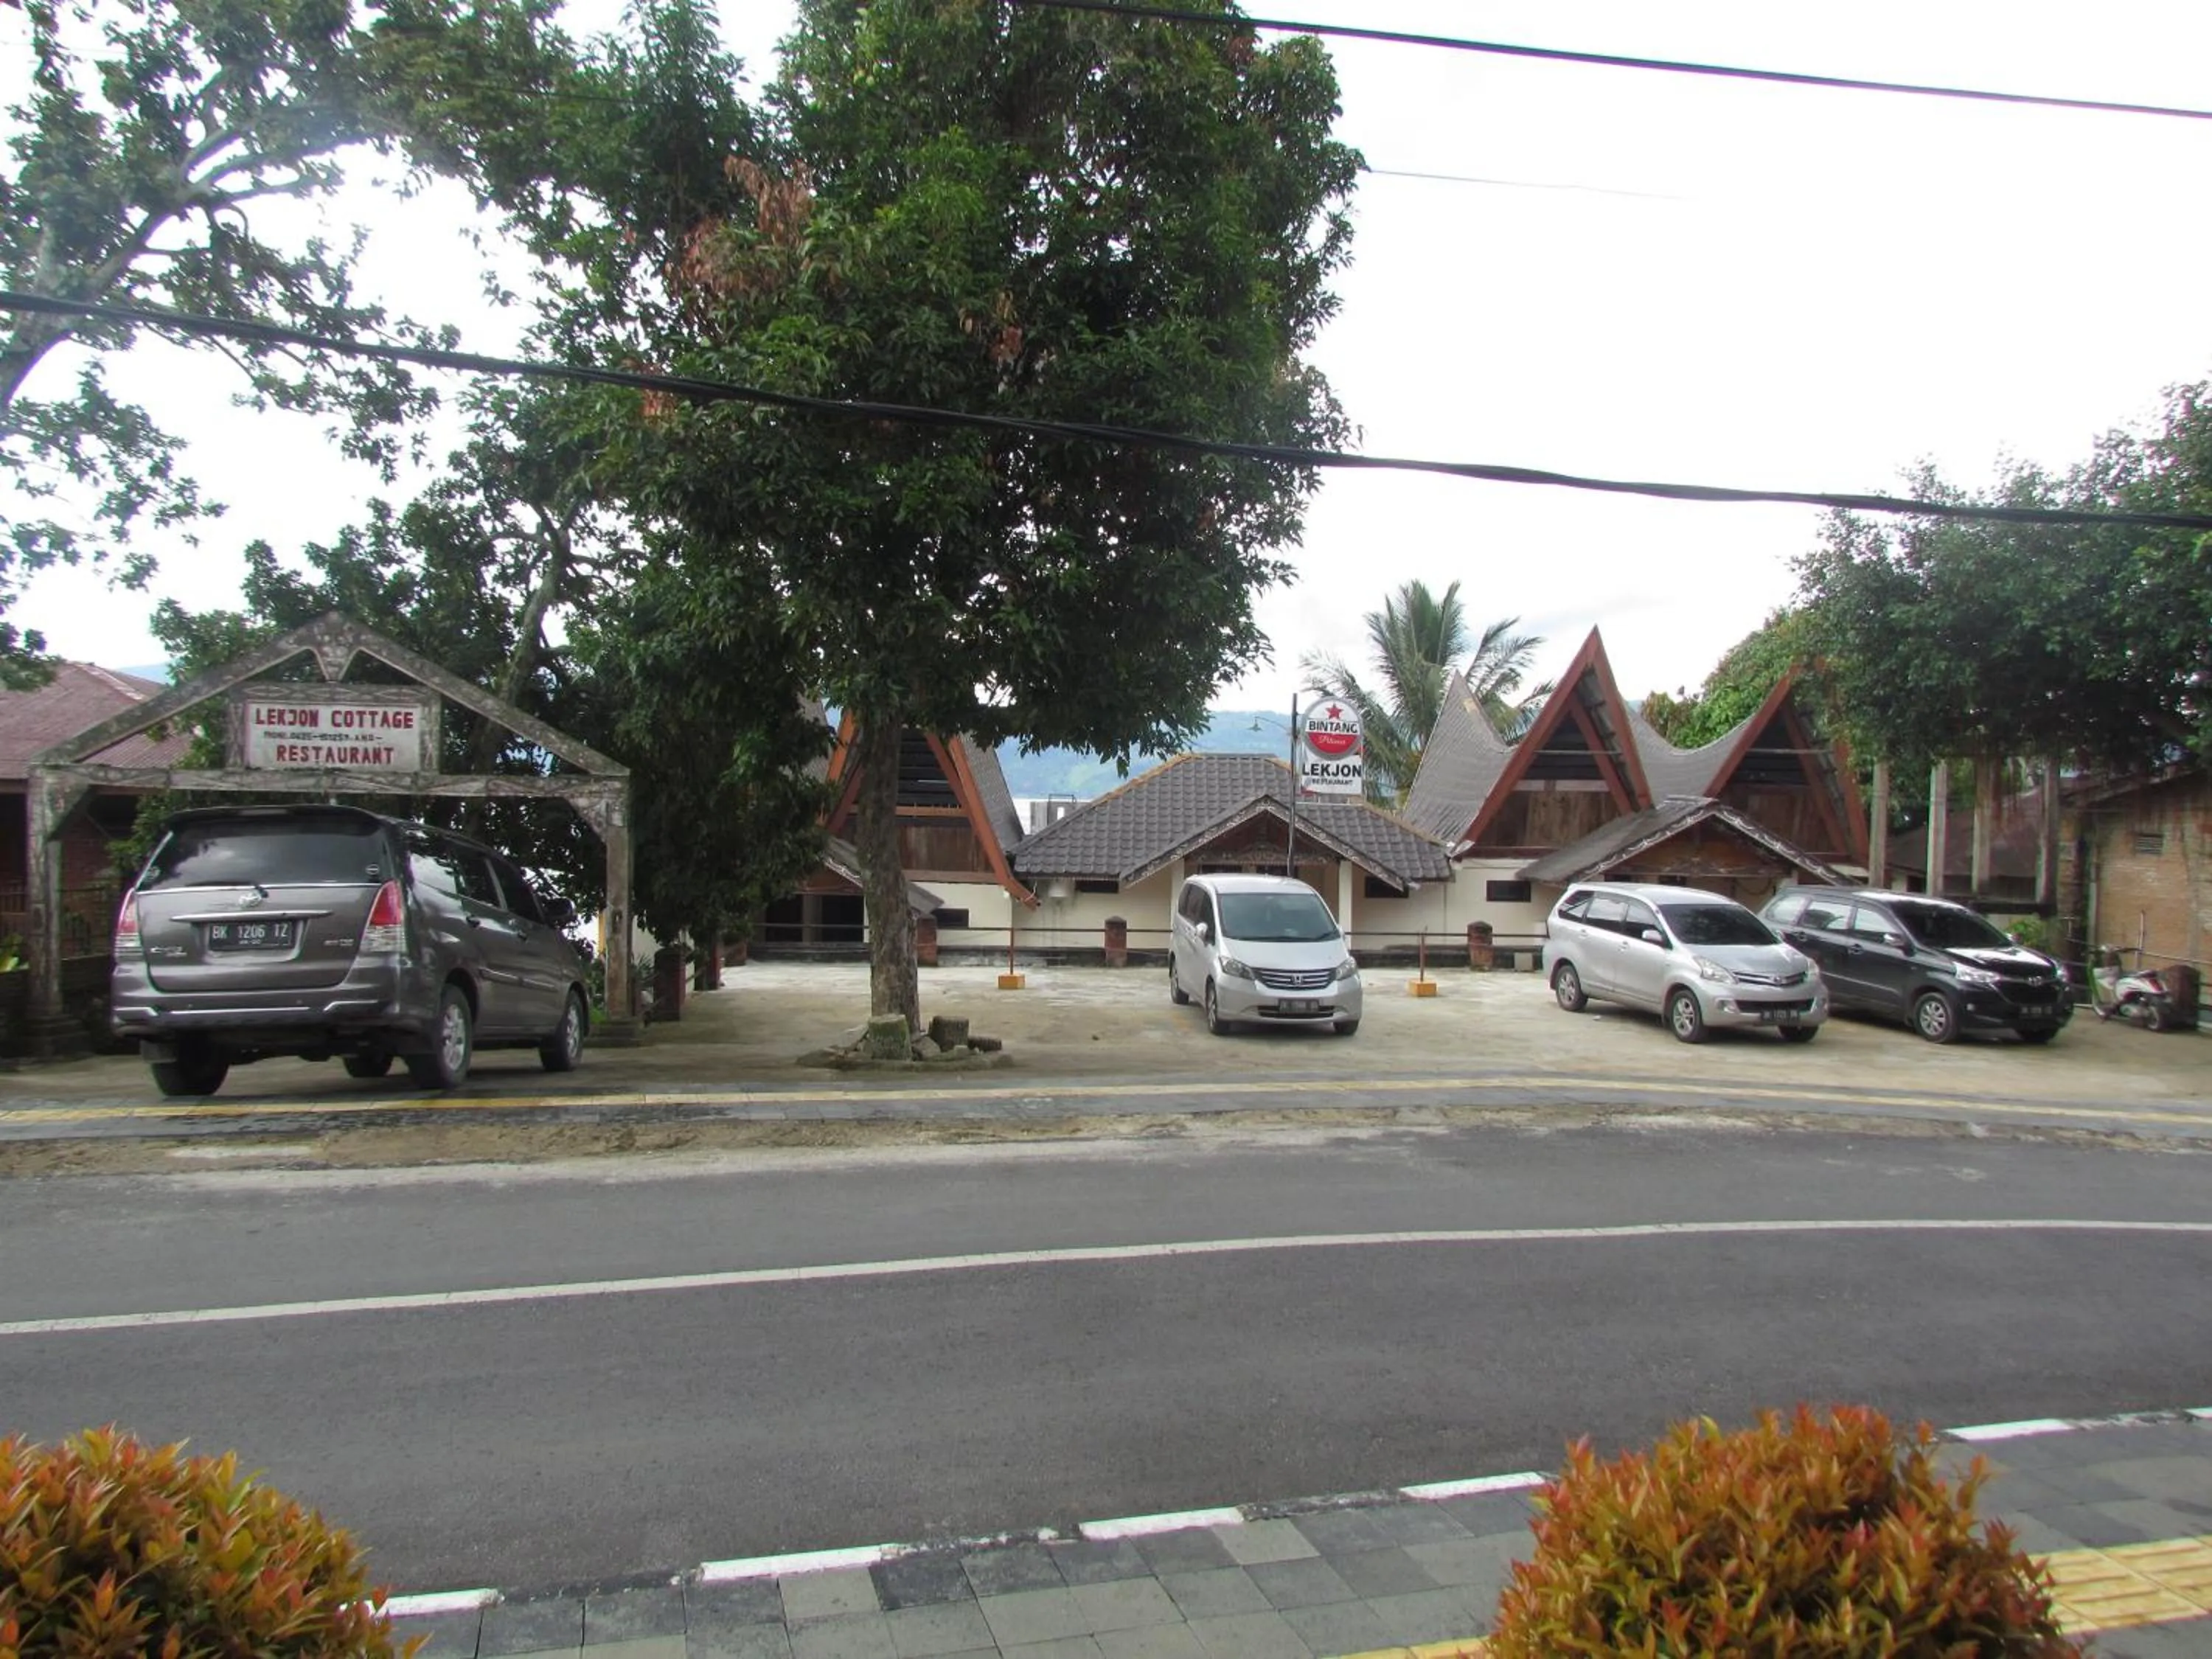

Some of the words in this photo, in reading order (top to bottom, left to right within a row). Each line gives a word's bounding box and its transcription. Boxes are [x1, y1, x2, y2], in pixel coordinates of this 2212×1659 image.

[255, 707, 319, 727] LEKJON
[331, 709, 414, 729] COTTAGE
[1308, 720, 1358, 734] BINTANG
[276, 745, 394, 765] RESTAURANT
[1301, 762, 1363, 778] LEKJON
[212, 925, 228, 939] BK
[237, 923, 266, 939] 1206
